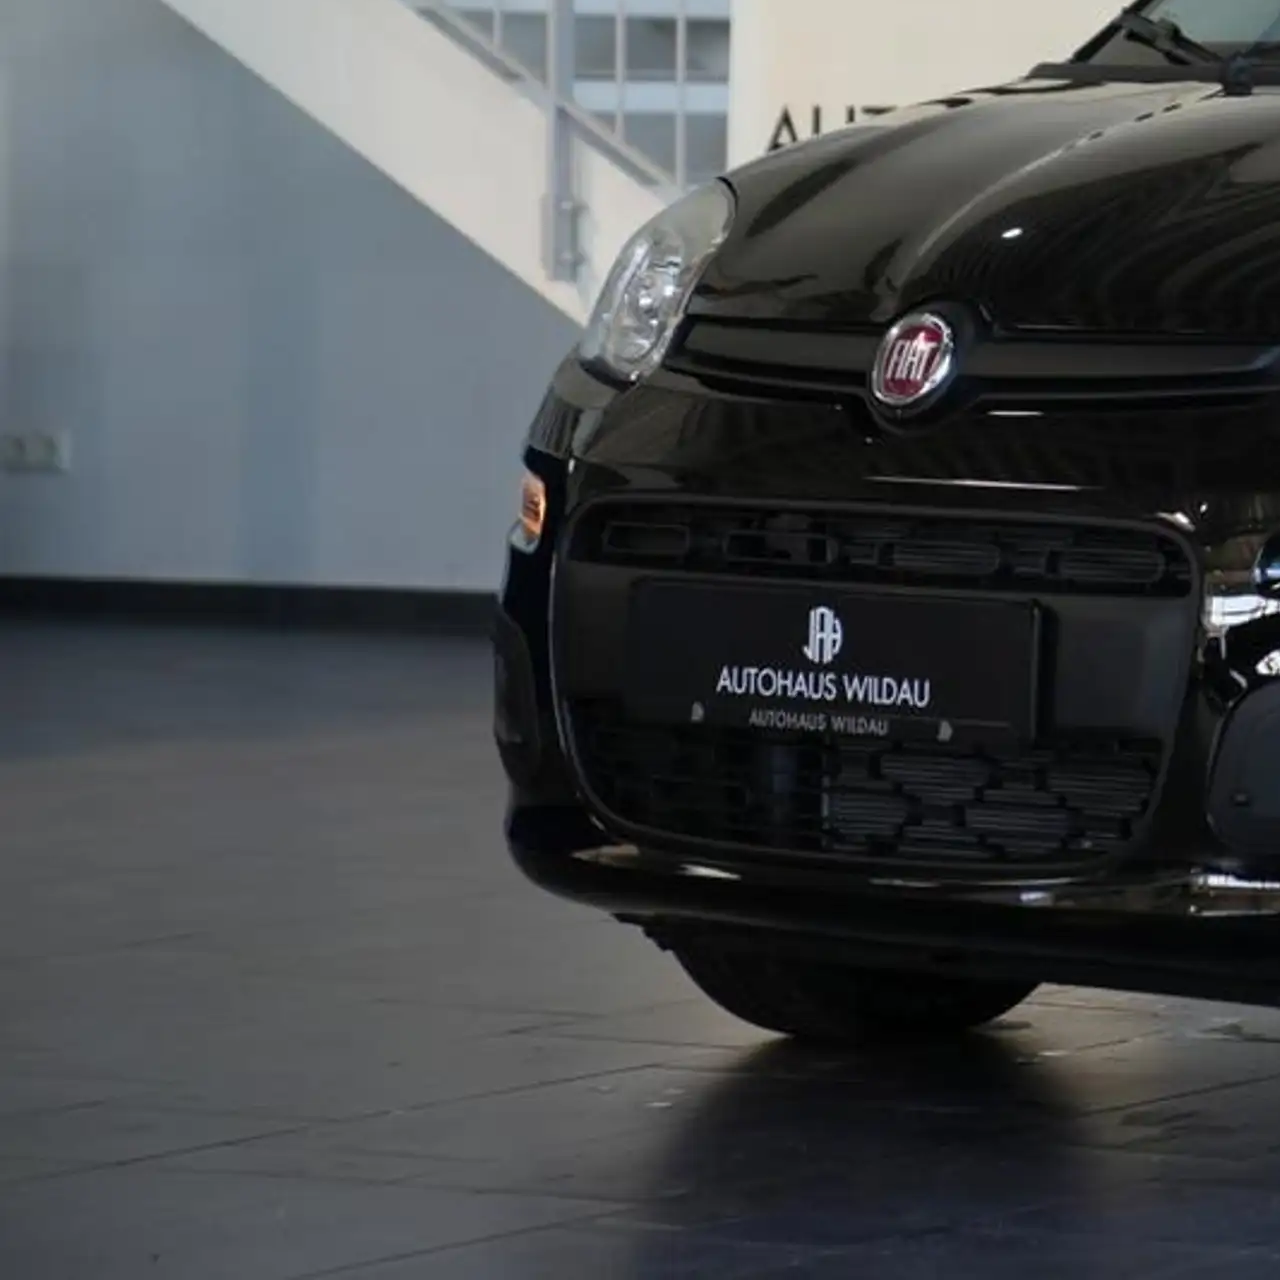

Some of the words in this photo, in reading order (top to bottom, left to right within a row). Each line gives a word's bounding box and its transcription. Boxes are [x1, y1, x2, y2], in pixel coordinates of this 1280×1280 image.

[716, 666, 837, 702] AUTOHAUS
[843, 674, 931, 708] WILDAU
[748, 707, 827, 732] AUTOHAUS
[830, 715, 889, 737] WILDAU
